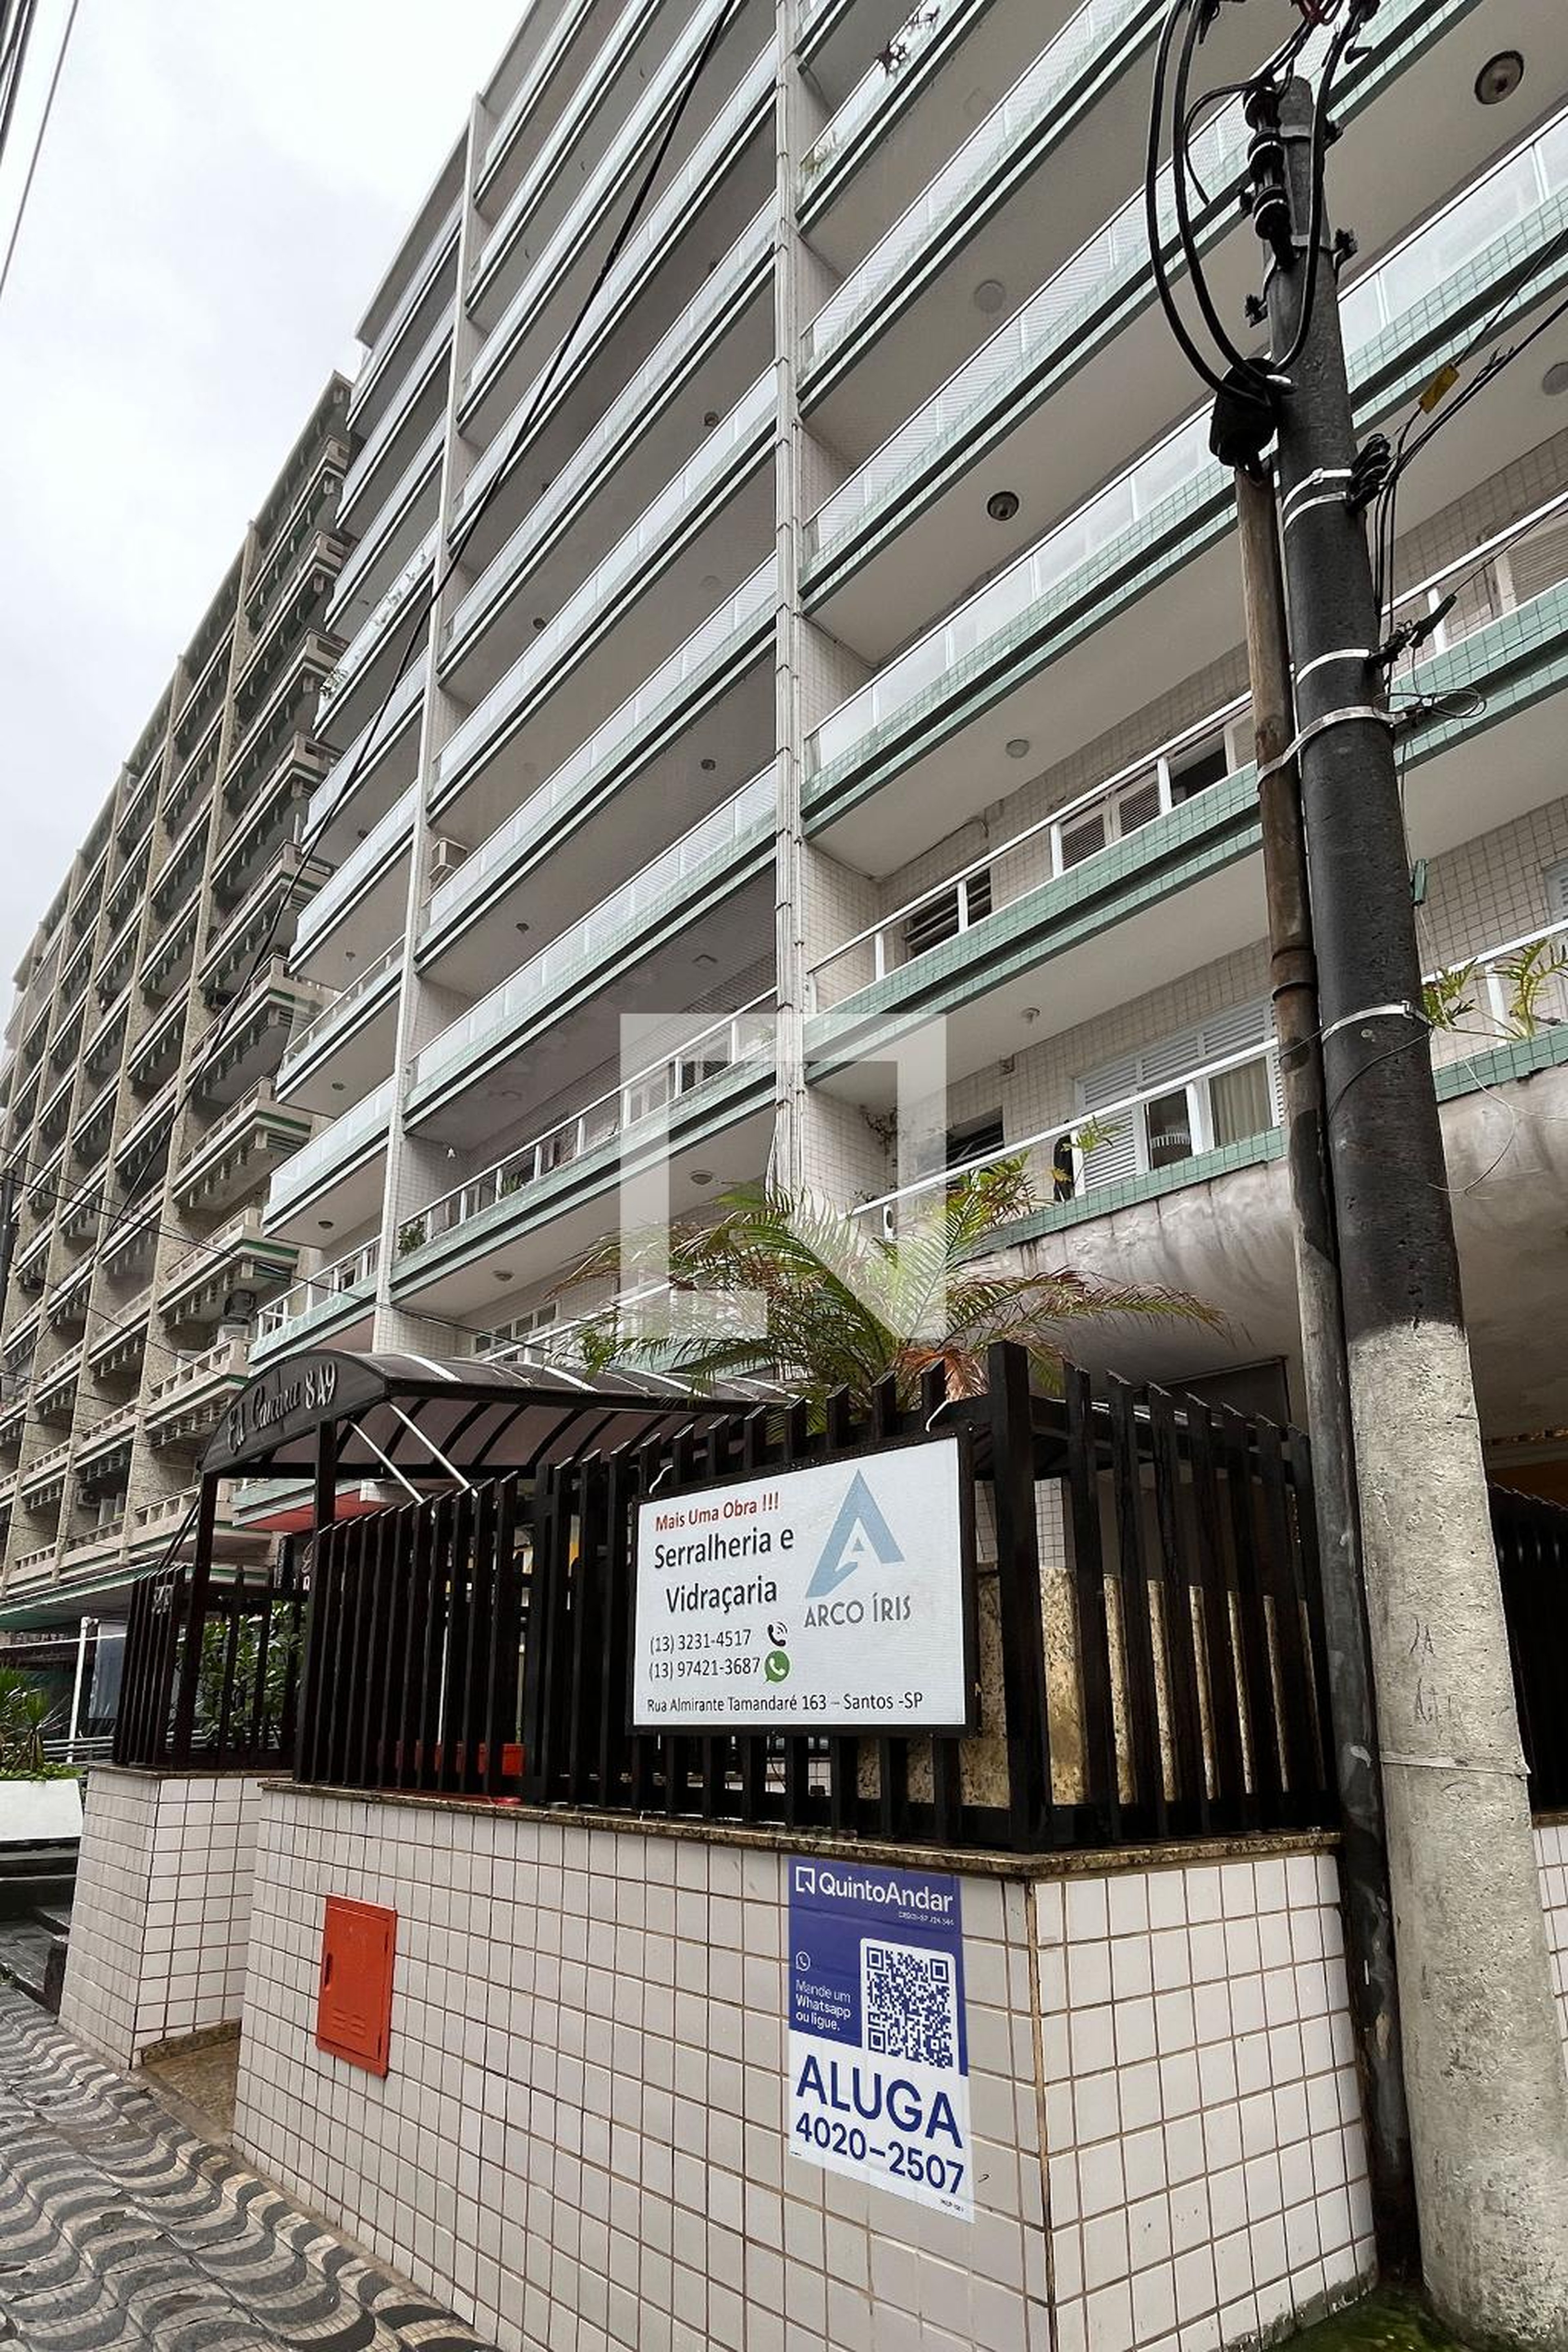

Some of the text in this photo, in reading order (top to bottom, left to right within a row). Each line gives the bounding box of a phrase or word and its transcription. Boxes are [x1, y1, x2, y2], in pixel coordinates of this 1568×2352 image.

[655, 1512, 685, 1531] Mais
[688, 1508, 719, 1525] Uma
[723, 1499, 757, 1519] Obra
[655, 1527, 794, 1569] Serralheria e
[666, 1575, 777, 1614] Vidraçaria
[804, 1592, 911, 1628] ARCO ÍRIS
[650, 1629, 751, 1655] (13) 3231-4517
[649, 1657, 760, 1682] (13) 97421-3687
[647, 1699, 667, 1712] Rua
[670, 1697, 725, 1712] Almirante
[727, 1695, 797, 1711] Tamandaré
[802, 1694, 826, 1710] 163
[843, 1693, 893, 1710] Santos
[818, 1871, 953, 1913] QuintoAndar
[796, 1980, 851, 2003] Mande um
[796, 1993, 851, 2020] Whatsapp
[796, 2011, 840, 2031] ou ligue.
[795, 2054, 963, 2149] ALUGA
[795, 2112, 964, 2194] 4020-2507
